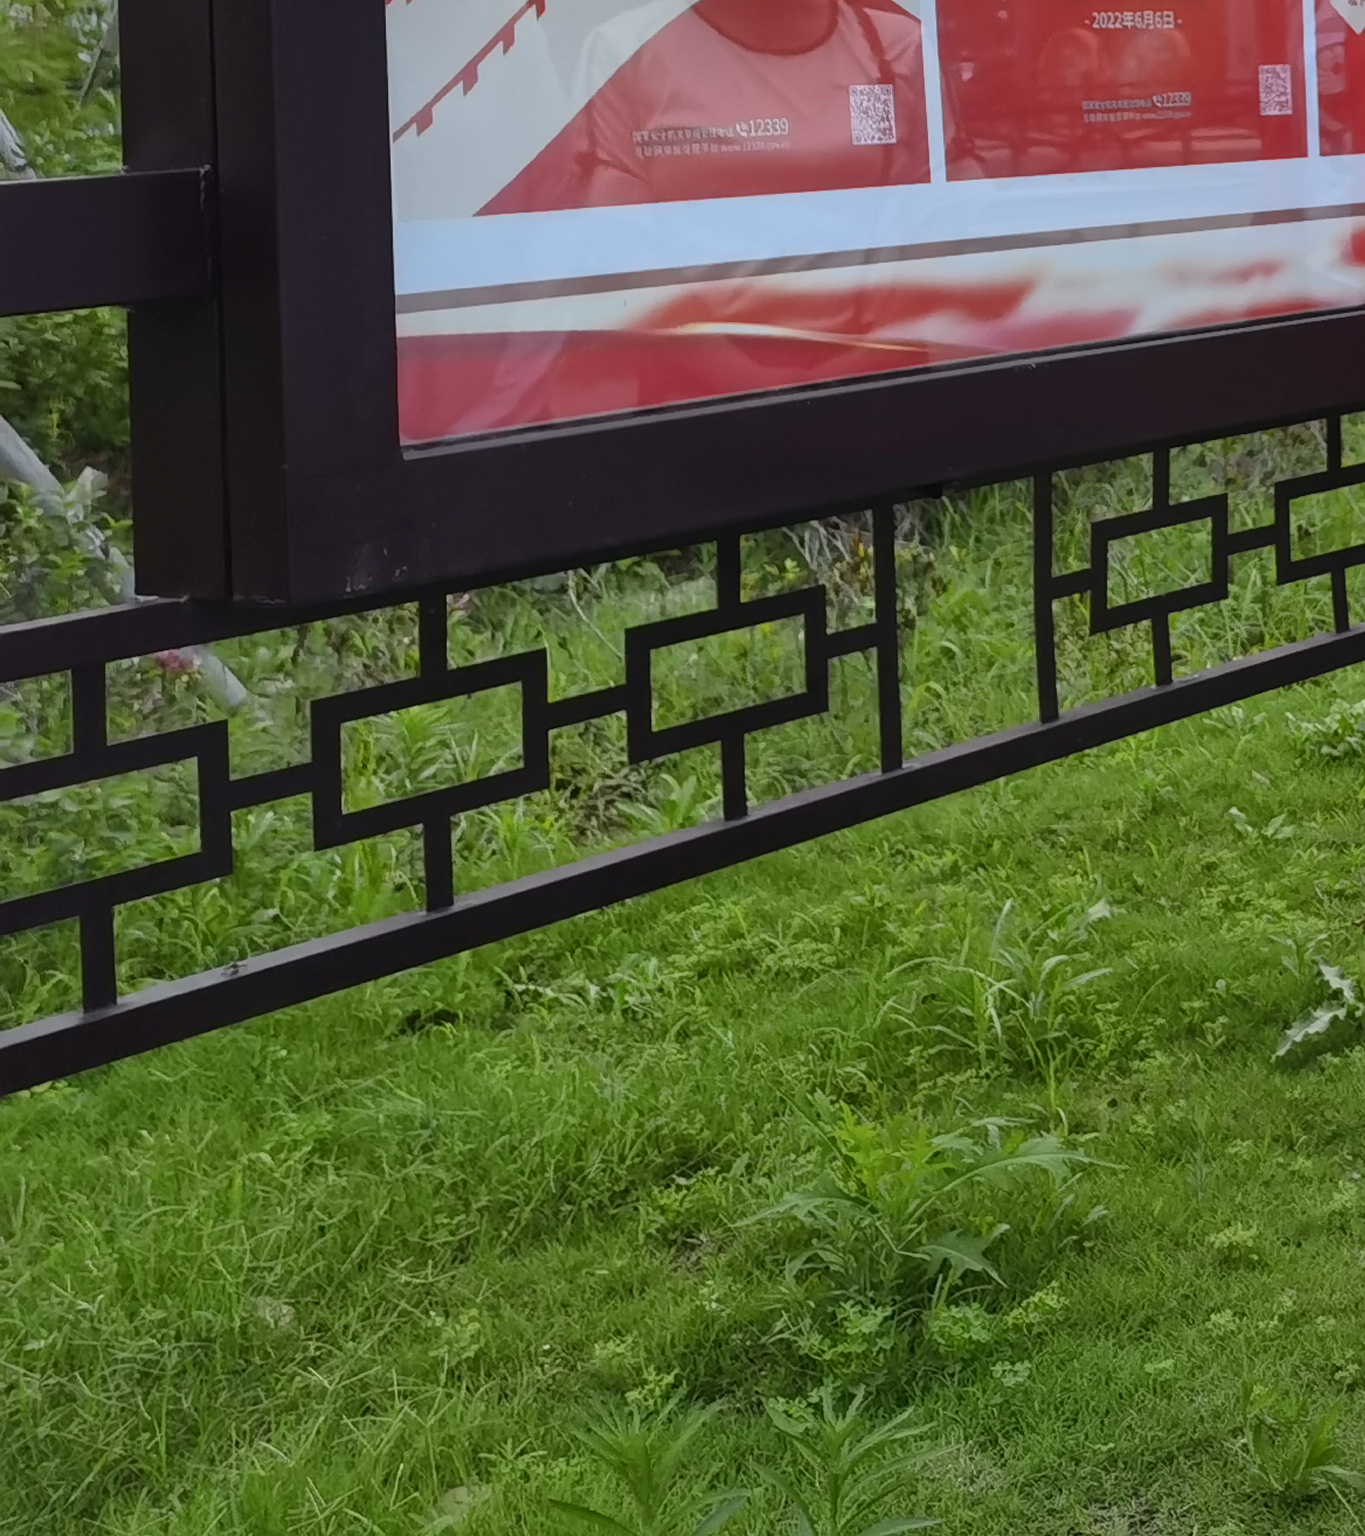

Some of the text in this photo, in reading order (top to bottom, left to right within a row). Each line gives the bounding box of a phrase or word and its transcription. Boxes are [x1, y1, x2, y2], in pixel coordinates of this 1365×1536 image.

[1091, 11, 1175, 30] 2022年6月6日
[750, 118, 789, 136] 12339
